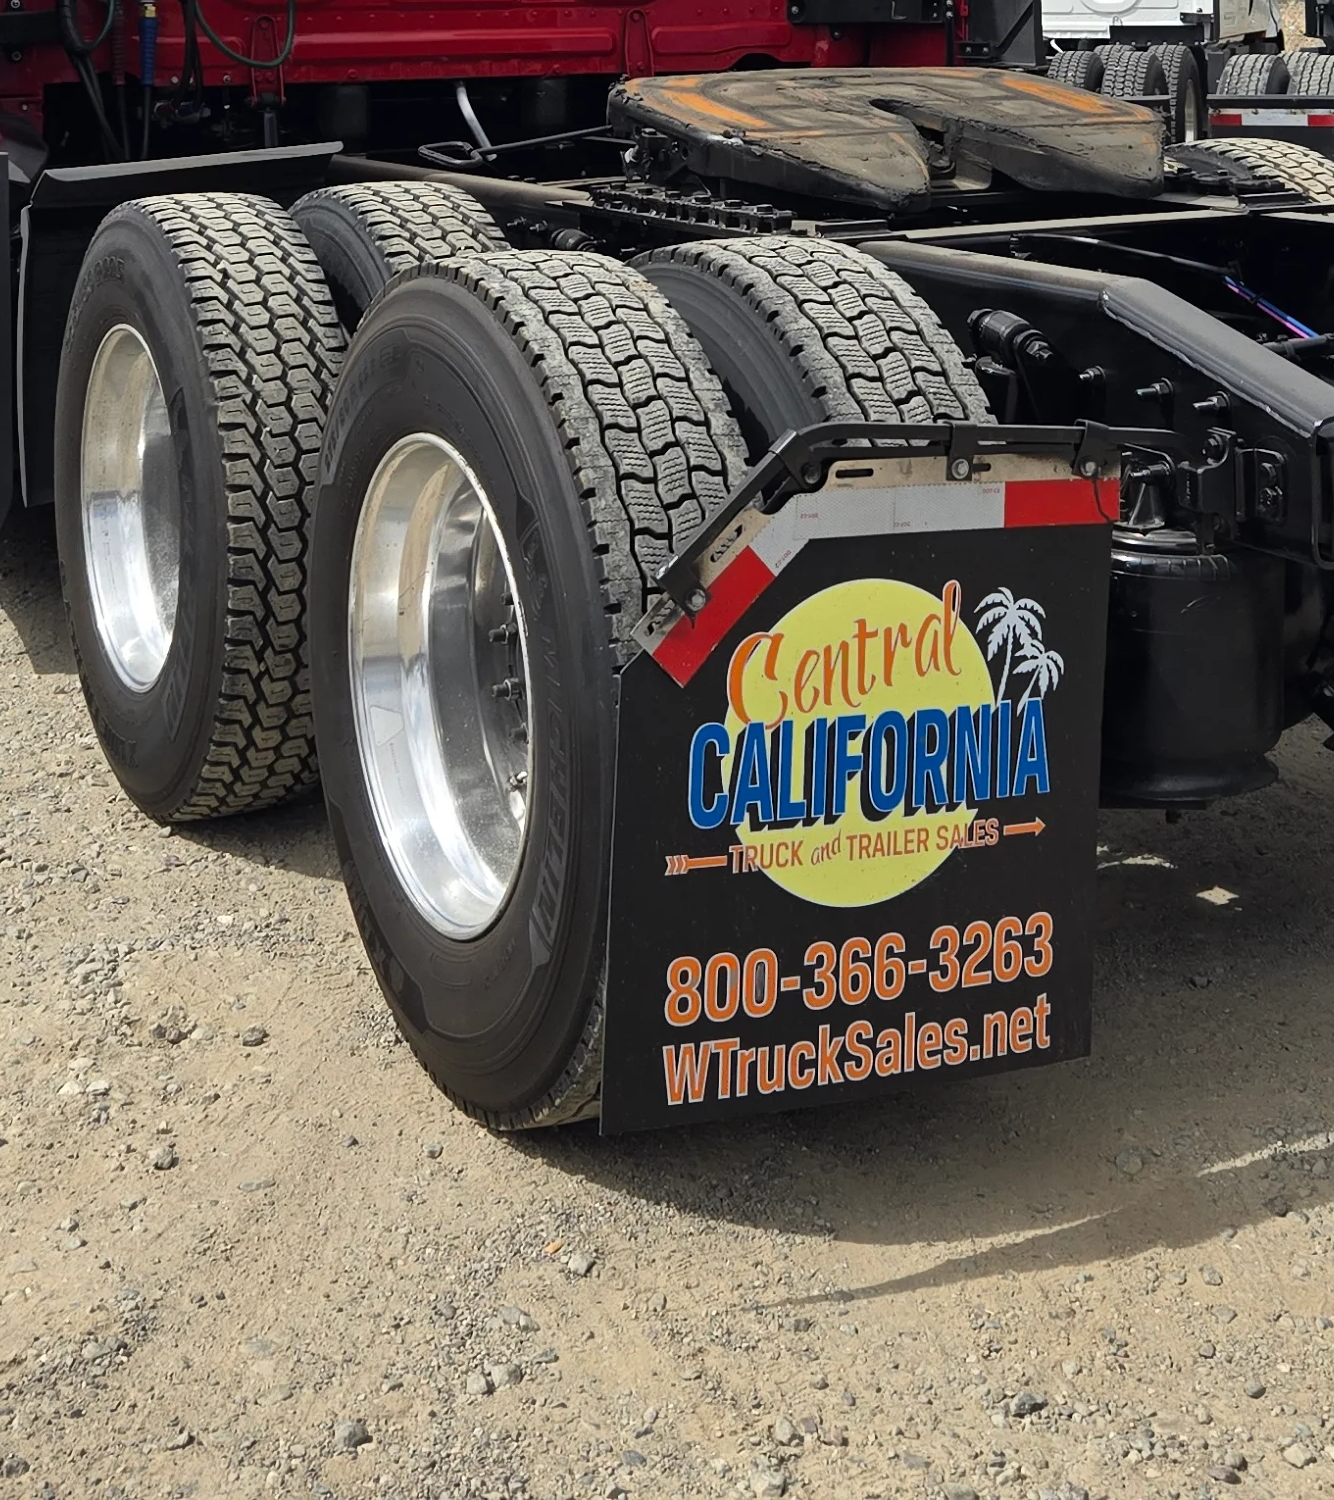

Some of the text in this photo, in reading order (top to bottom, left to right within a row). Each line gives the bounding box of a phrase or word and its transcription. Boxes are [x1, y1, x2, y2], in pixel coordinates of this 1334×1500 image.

[727, 580, 962, 728] Central
[689, 697, 1050, 831] CALIFORNIA
[730, 817, 1000, 875] TRUCK and TRAILER SALES
[664, 910, 1054, 1028] 800-366-3263
[662, 994, 1052, 1106] WTruckSales.net
